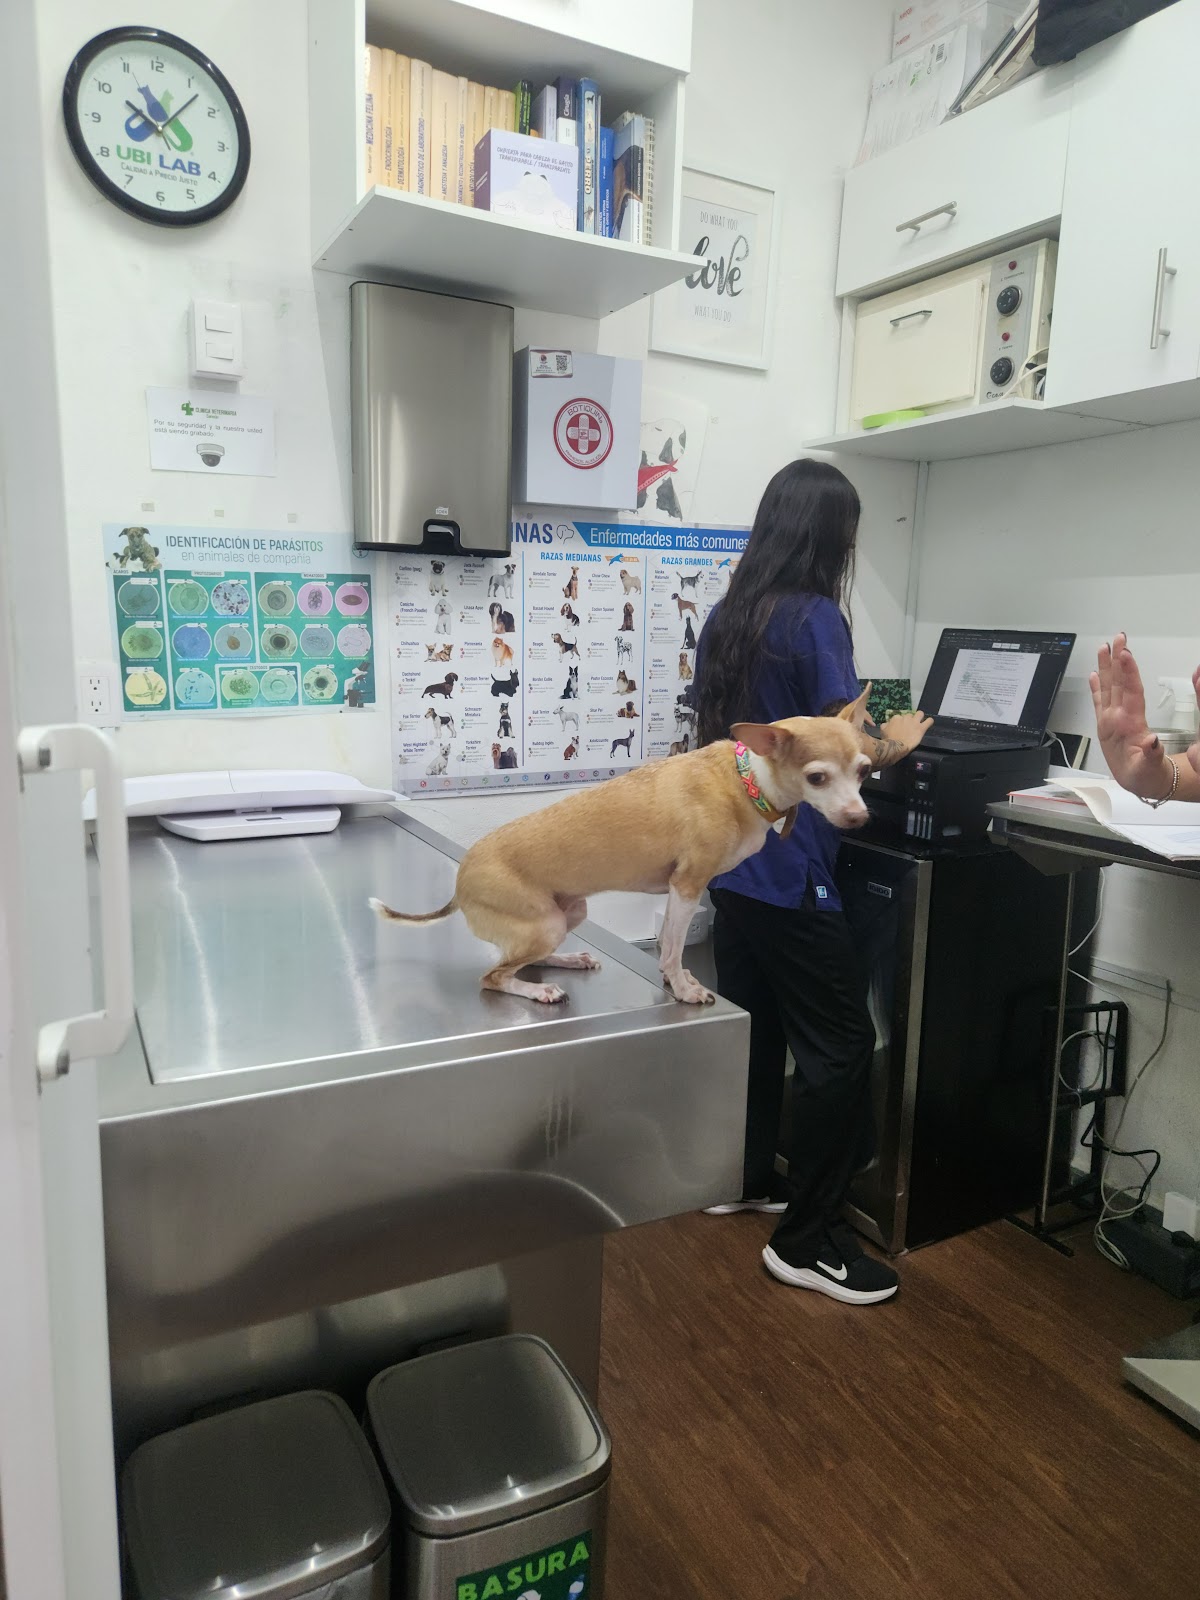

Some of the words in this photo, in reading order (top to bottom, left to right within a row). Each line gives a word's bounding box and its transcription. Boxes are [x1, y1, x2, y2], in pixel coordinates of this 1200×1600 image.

[123, 62, 129, 73] 11
[151, 60, 164, 73] 12
[98, 81, 112, 94] 10
[187, 78, 191, 88] 1
[92, 112, 101, 123] 9
[208, 108, 216, 118] 2
[100, 146, 110, 157] 8
[218, 142, 225, 152] 3
[116, 144, 151, 165] UBI
[159, 154, 201, 176] LAB
[397, 147, 405, 185] DERMATOLOGÍA
[125, 175, 134, 185] 7
[208, 172, 216, 181] 4
[156, 191, 165, 202] 6
[186, 189, 195, 200] 5
[700, 211, 708, 223] DO
[710, 213, 726, 227] WHAT
[728, 217, 738, 231] YOU
[685, 235, 749, 297] love
[695, 305, 710, 318] WHAT
[712, 308, 721, 320] YOU
[724, 310, 731, 322] DO
[178, 422, 206, 430] seguridad
[166, 535, 250, 549] IDENTIFICACIÓN
[254, 539, 266, 550] DE
[270, 538, 323, 552] PARÁSITOS
[590, 527, 672, 547] Enfermedades
[676, 532, 699, 548] más
[702, 536, 749, 550] comunes
[182, 552, 194, 561] en
[198, 551, 245, 563] animales
[248, 551, 260, 563] de
[263, 554, 311, 566] compañía
[540, 552, 563, 561] RAZAS
[566, 553, 602, 562] MEDIANAS
[661, 557, 682, 565] RAZAS
[684, 558, 713, 566] GRANDES
[458, 1541, 589, 1600] BASURA
